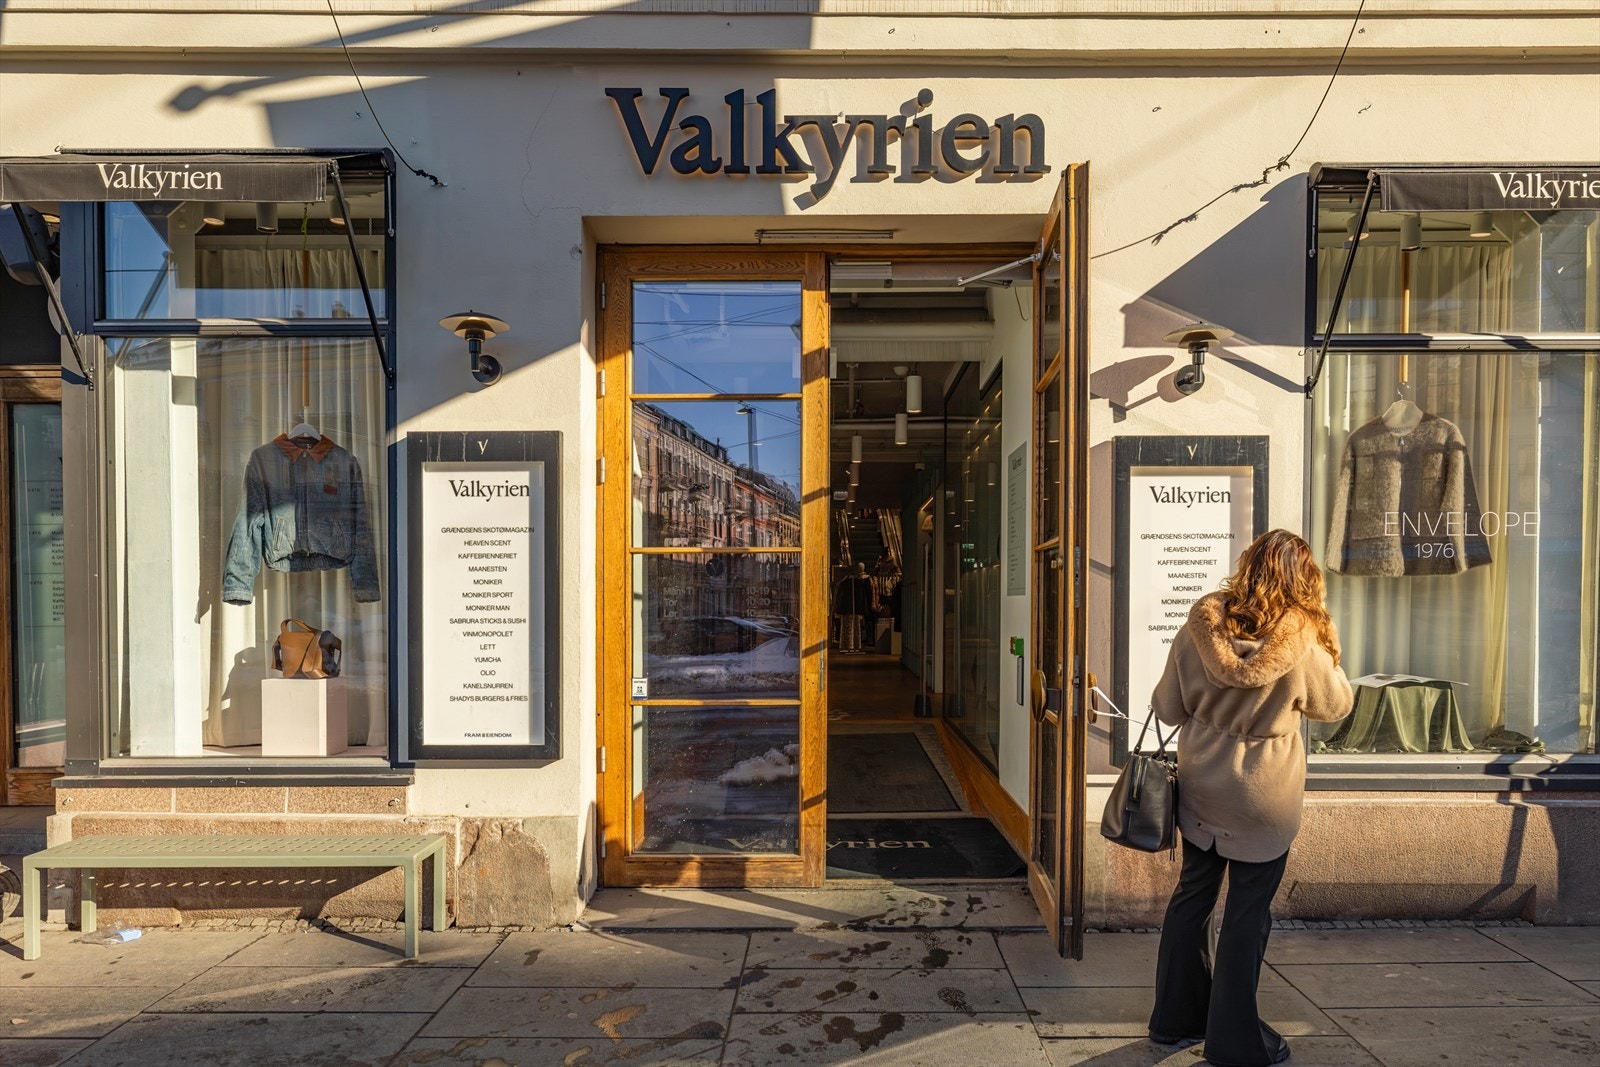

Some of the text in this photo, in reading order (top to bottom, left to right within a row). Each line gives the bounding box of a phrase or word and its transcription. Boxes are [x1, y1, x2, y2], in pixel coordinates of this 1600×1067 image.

[604, 87, 1051, 200] Valkyrien
[96, 163, 224, 198] Valkyrien
[1490, 172, 1600, 208] Valkyrie
[449, 480, 530, 502] Valkyrien
[1149, 485, 1231, 508] Valkyrien
[1384, 511, 1539, 537] ENVELOPE
[1414, 542, 1455, 559] 1976
